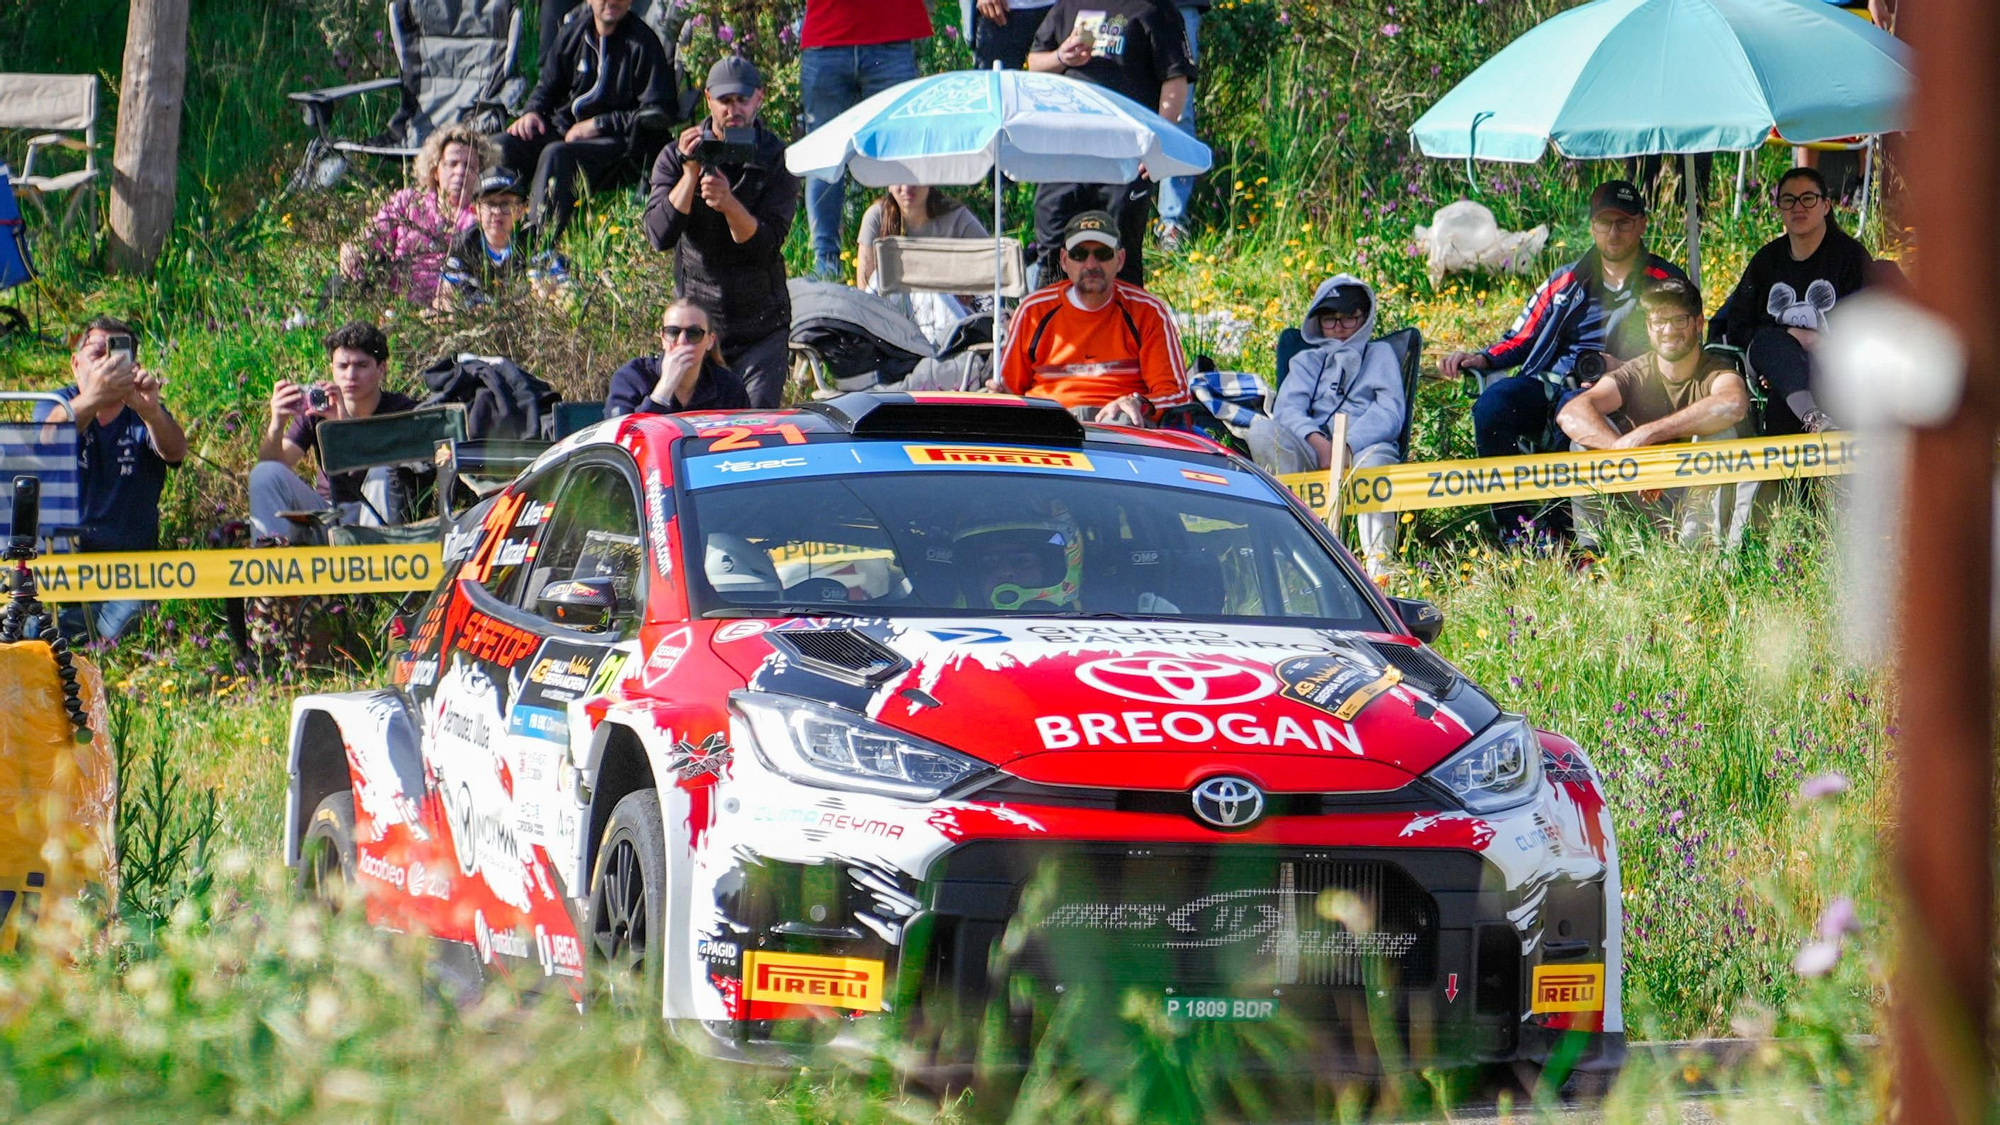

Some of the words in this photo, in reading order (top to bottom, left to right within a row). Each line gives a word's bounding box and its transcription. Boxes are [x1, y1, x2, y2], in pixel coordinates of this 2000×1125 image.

[701, 423, 807, 452] 21
[727, 457, 809, 473] ERC
[925, 447, 1074, 467] PIRELLI
[1675, 449, 1755, 478] ZONA
[1428, 468, 1504, 497] ZONA
[1514, 457, 1639, 489] PUBLICO
[455, 492, 526, 583] 21
[229, 557, 303, 587] ZONA
[312, 553, 430, 584] PUBLICO
[1132, 551, 1159, 562] OMP
[78, 561, 196, 590] PUBLICO
[1026, 625, 1228, 639] GRUPO
[1041, 635, 1330, 652] BARREIRO
[1034, 711, 1364, 755] BREOGAN
[359, 847, 405, 886] Xacobeo
[706, 941, 737, 957] PAGID
[757, 964, 869, 999] PIRELLI
[1538, 974, 1596, 1004] PIRELLI
[1167, 1001, 1178, 1016] P
[1185, 1000, 1227, 1018] 1809
[1233, 1001, 1273, 1018] BDR
